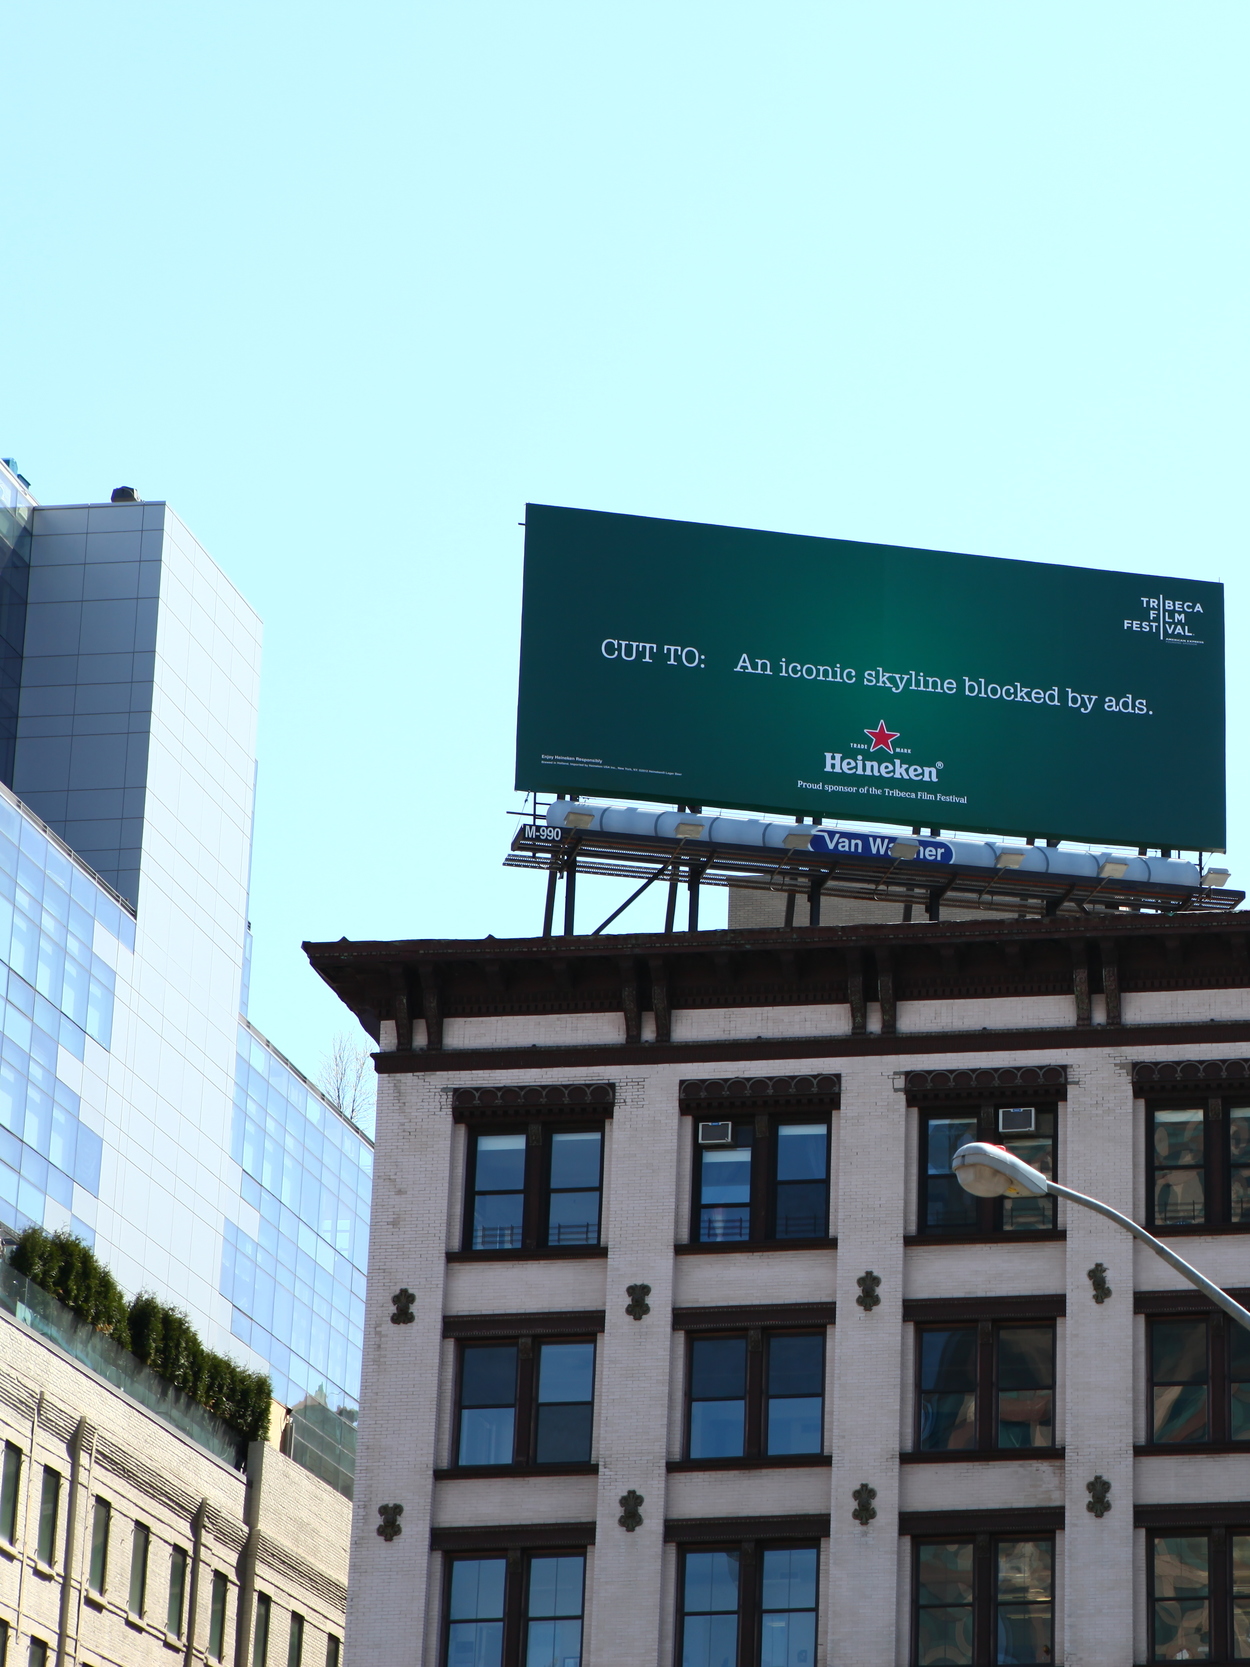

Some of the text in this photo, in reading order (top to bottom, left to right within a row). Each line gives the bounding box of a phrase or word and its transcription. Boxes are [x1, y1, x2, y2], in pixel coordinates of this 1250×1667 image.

[601, 638, 1153, 715] CUT TO: An iconic skyline blocked by ads.
[797, 780, 967, 804] Proud sponsor of the Tribeca Film Festival
[525, 826, 561, 840] M-990
[824, 832, 944, 860] Van Wner
